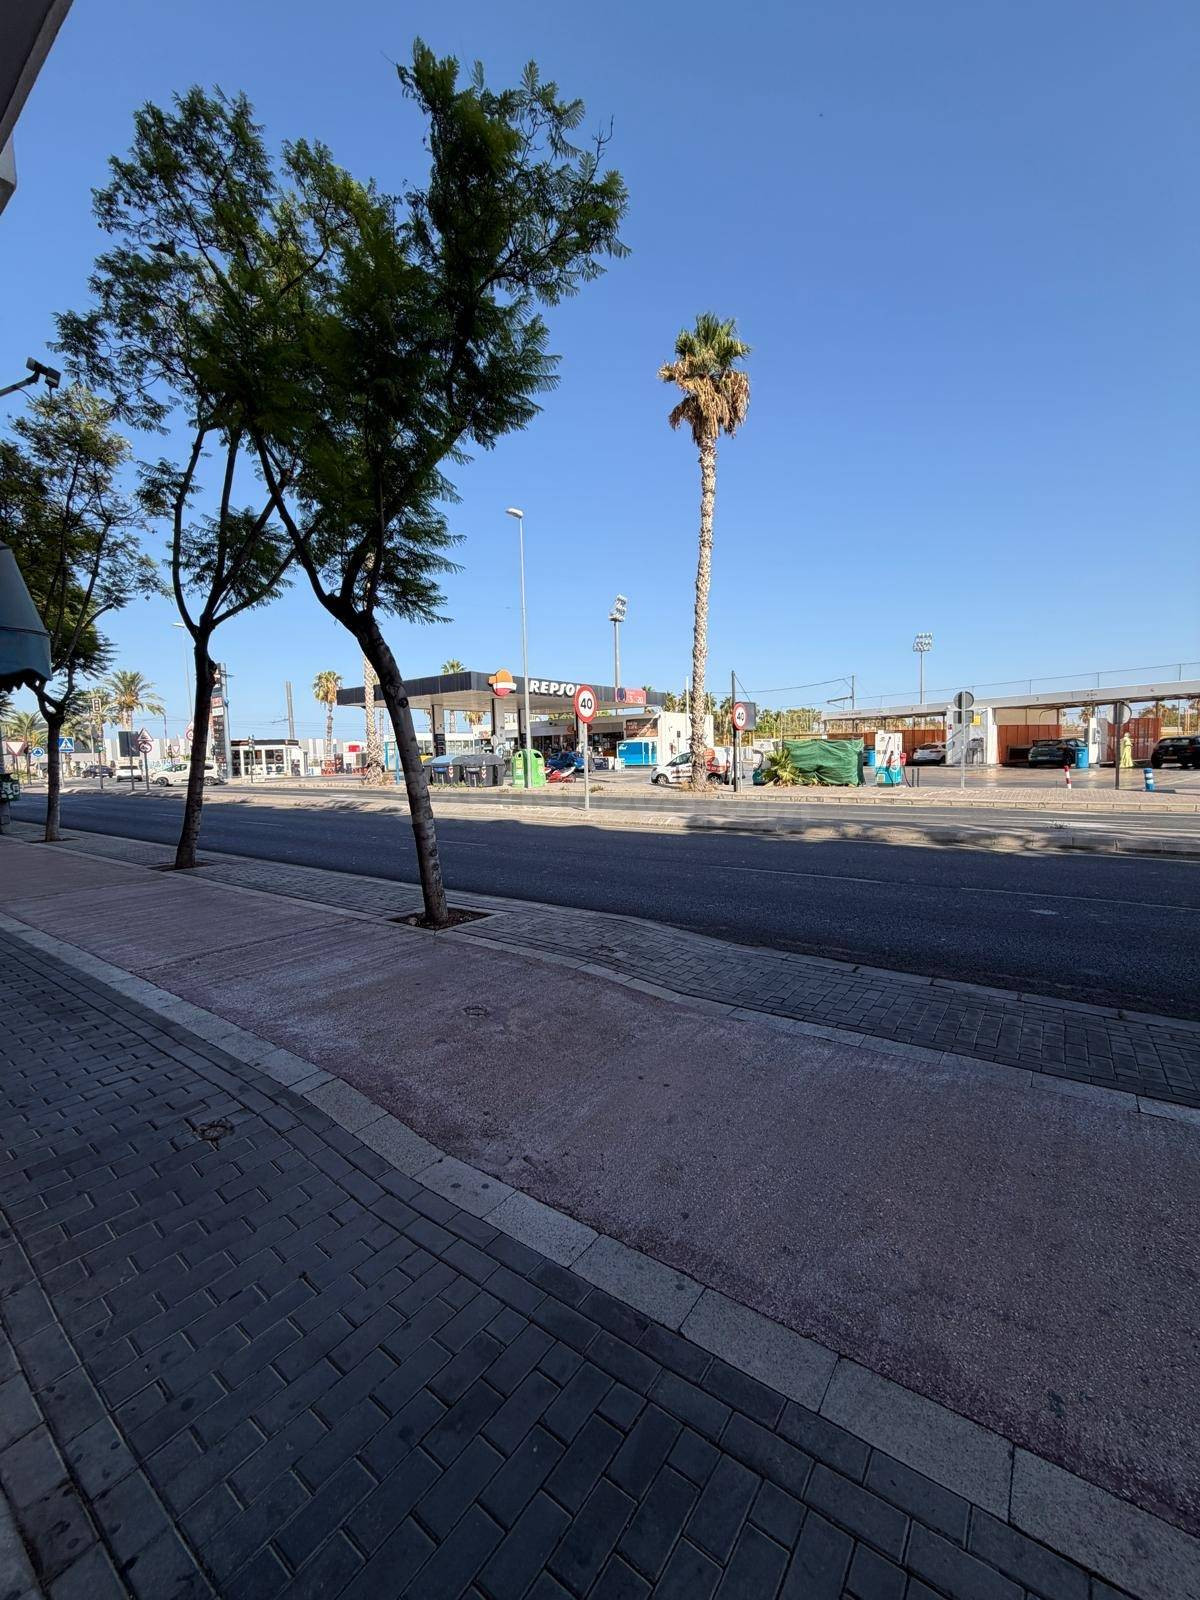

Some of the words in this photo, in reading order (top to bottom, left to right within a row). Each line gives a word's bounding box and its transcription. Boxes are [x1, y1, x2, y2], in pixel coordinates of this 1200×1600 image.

[529, 680, 580, 697] REPSO
[580, 698, 593, 710] 40
[736, 712, 745, 722] 40
